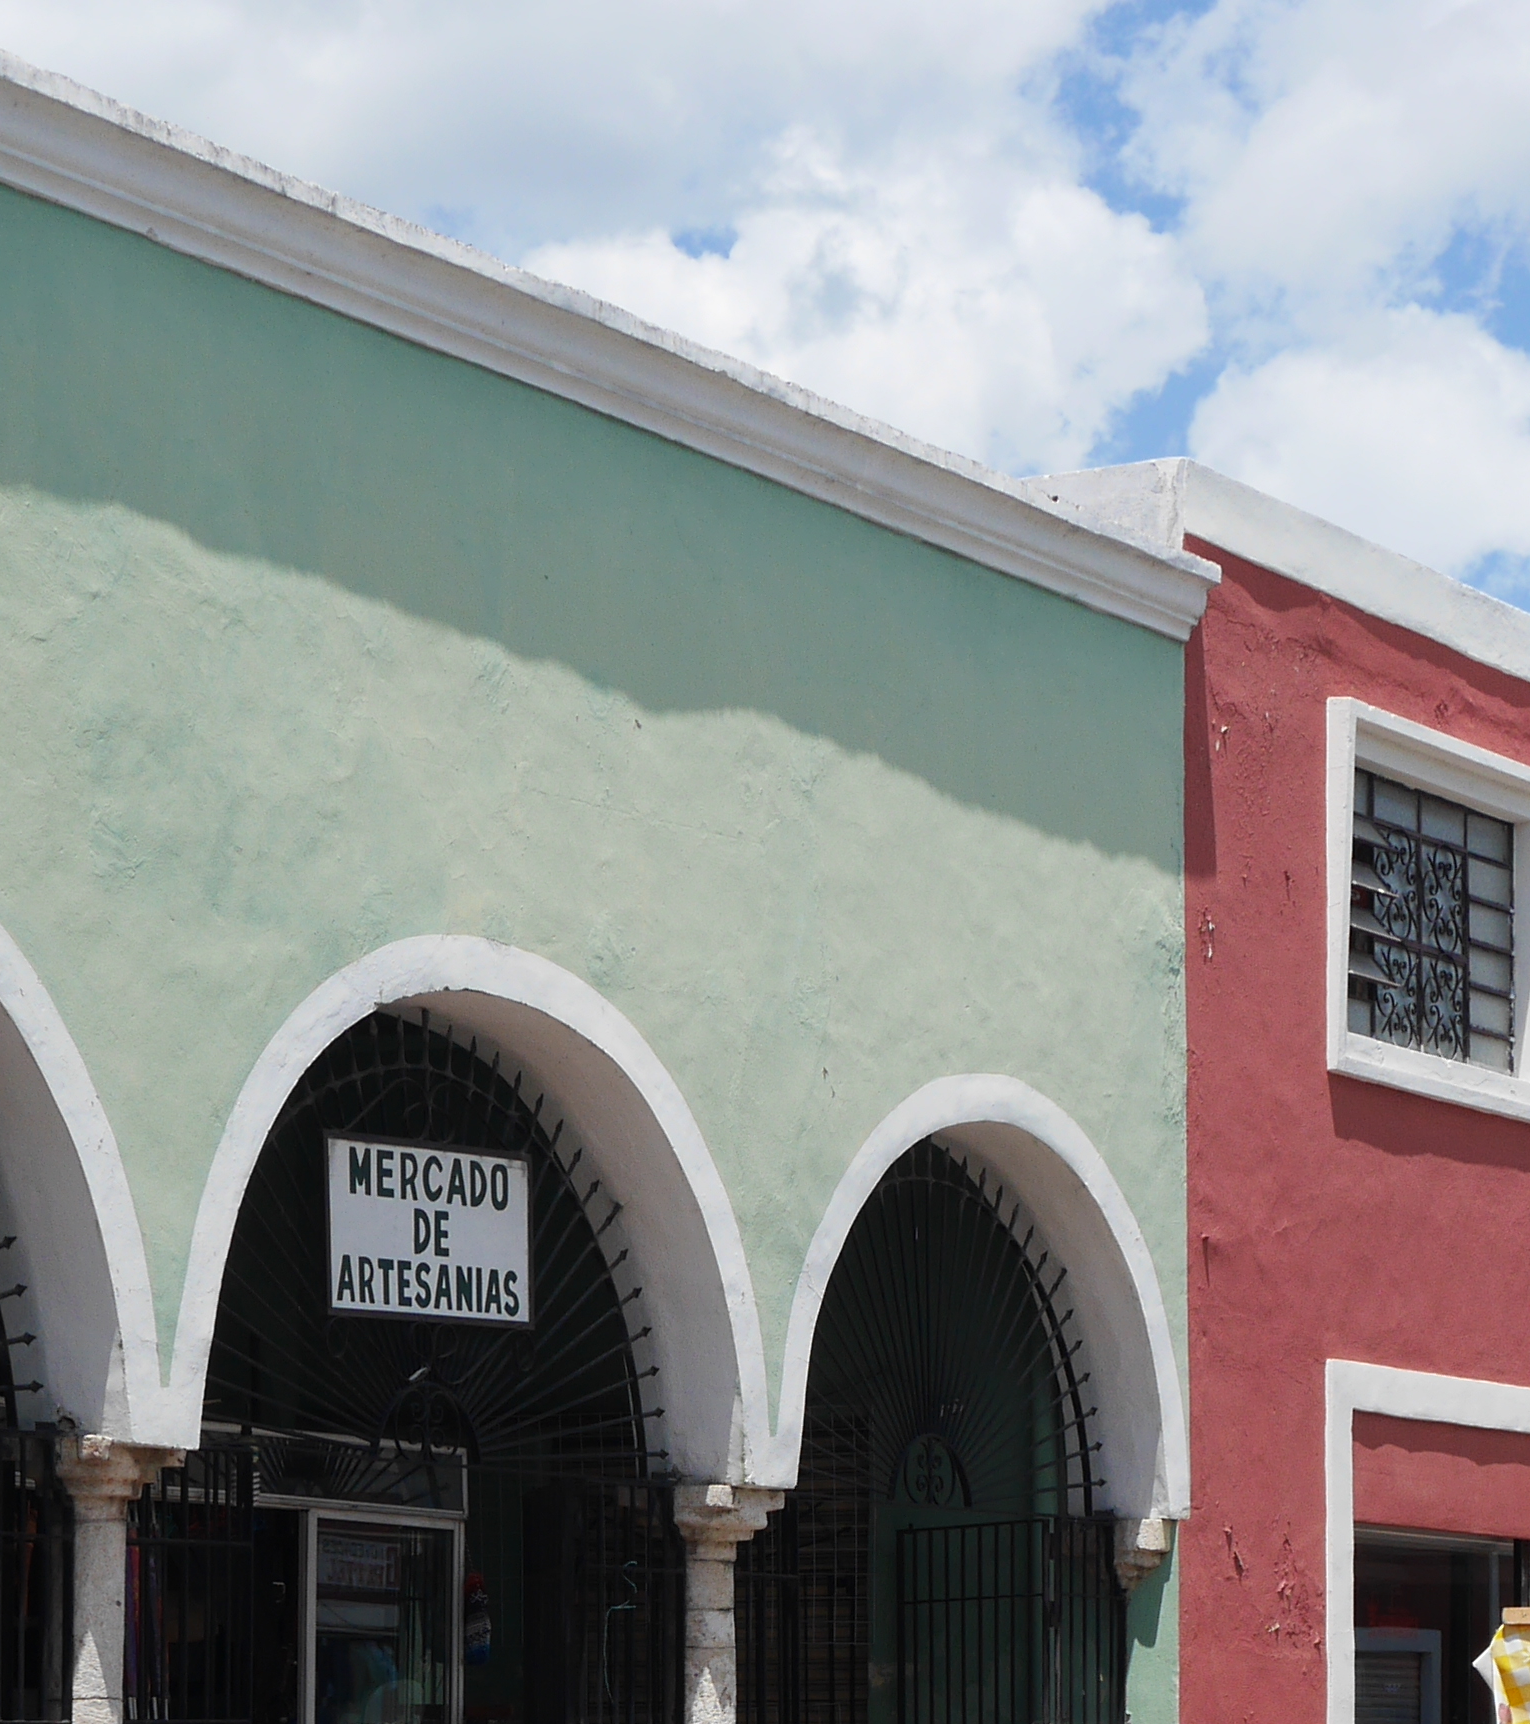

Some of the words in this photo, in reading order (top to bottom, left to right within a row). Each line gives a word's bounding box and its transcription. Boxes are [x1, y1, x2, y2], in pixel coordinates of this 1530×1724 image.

[349, 1146, 508, 1211] MERCADO
[413, 1208, 449, 1257] DE
[337, 1254, 519, 1317] ARTESANIAS
